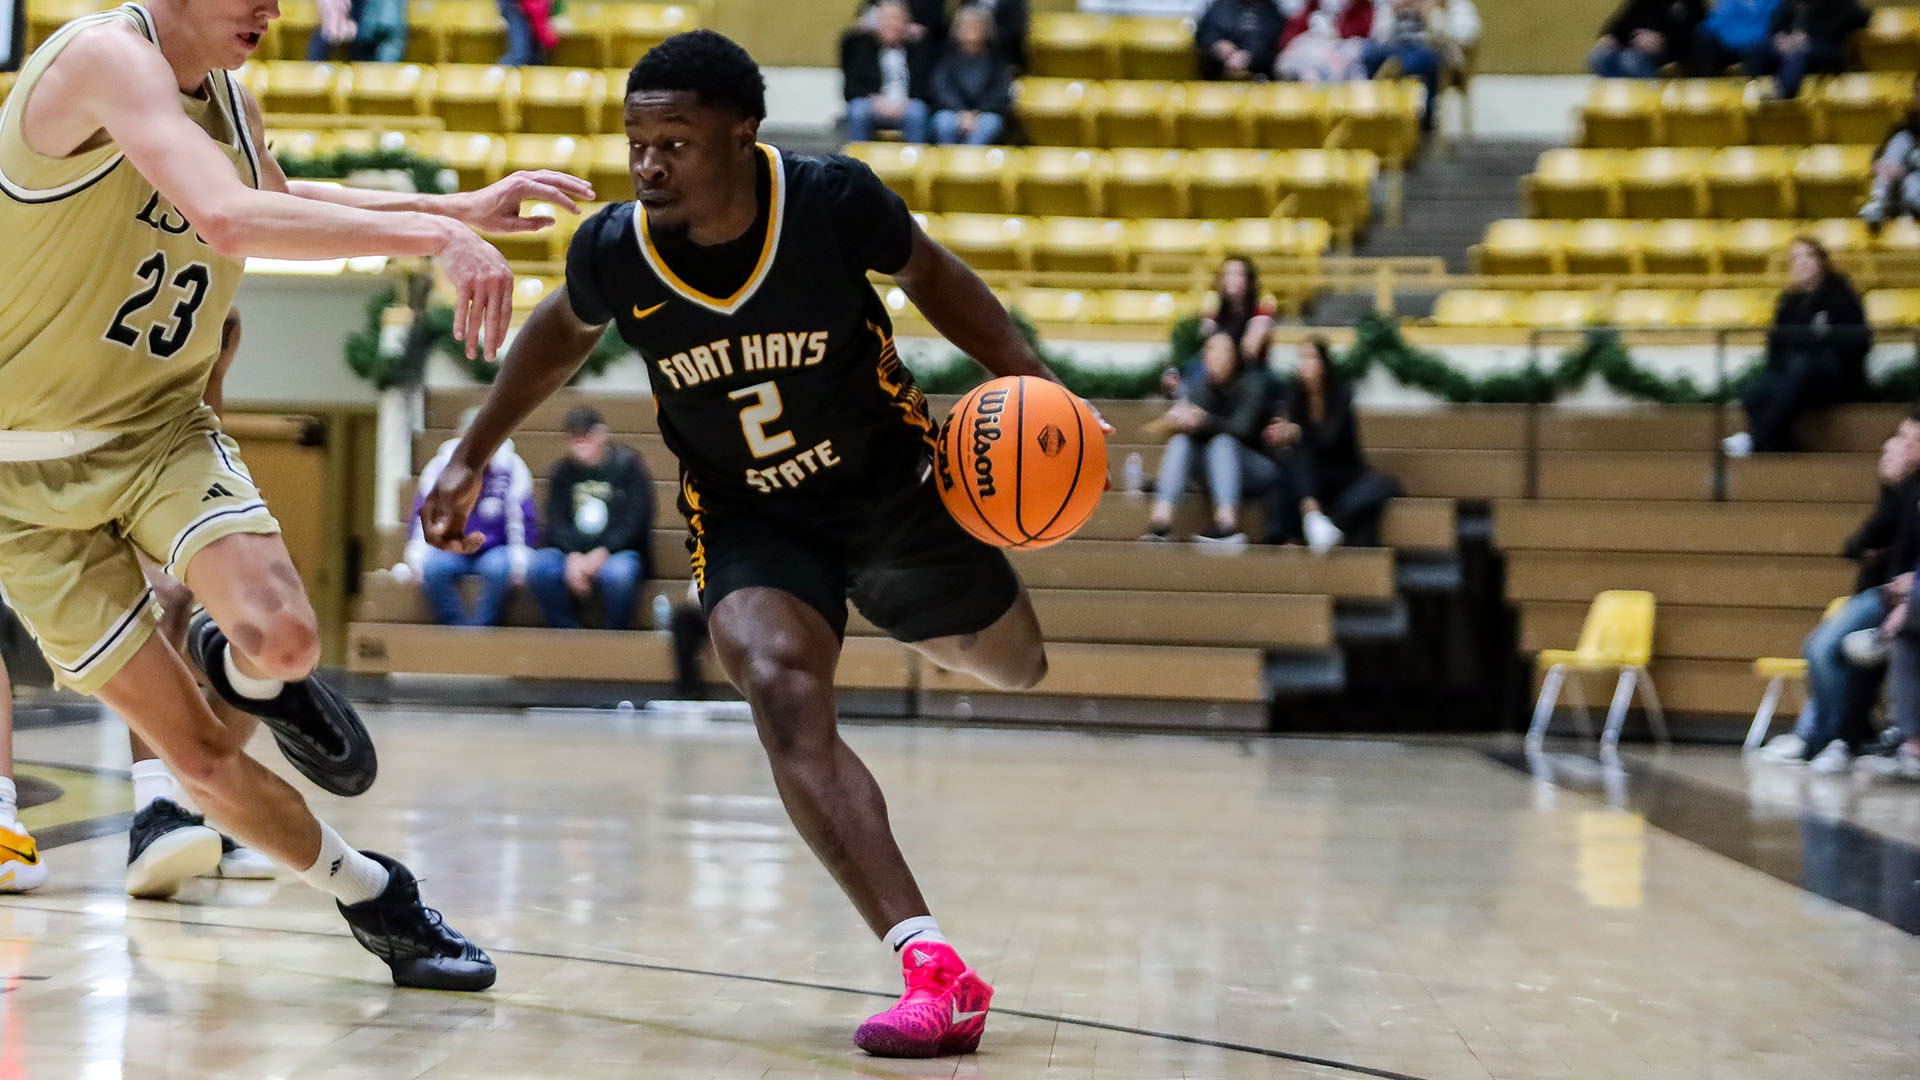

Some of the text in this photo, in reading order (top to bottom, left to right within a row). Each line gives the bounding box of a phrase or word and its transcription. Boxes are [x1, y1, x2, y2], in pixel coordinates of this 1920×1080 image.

[102, 250, 212, 360] 23
[658, 330, 829, 390] FORT HAYS
[728, 380, 797, 458] 2
[973, 387, 1010, 501] Wilson
[745, 439, 841, 493] STATE
